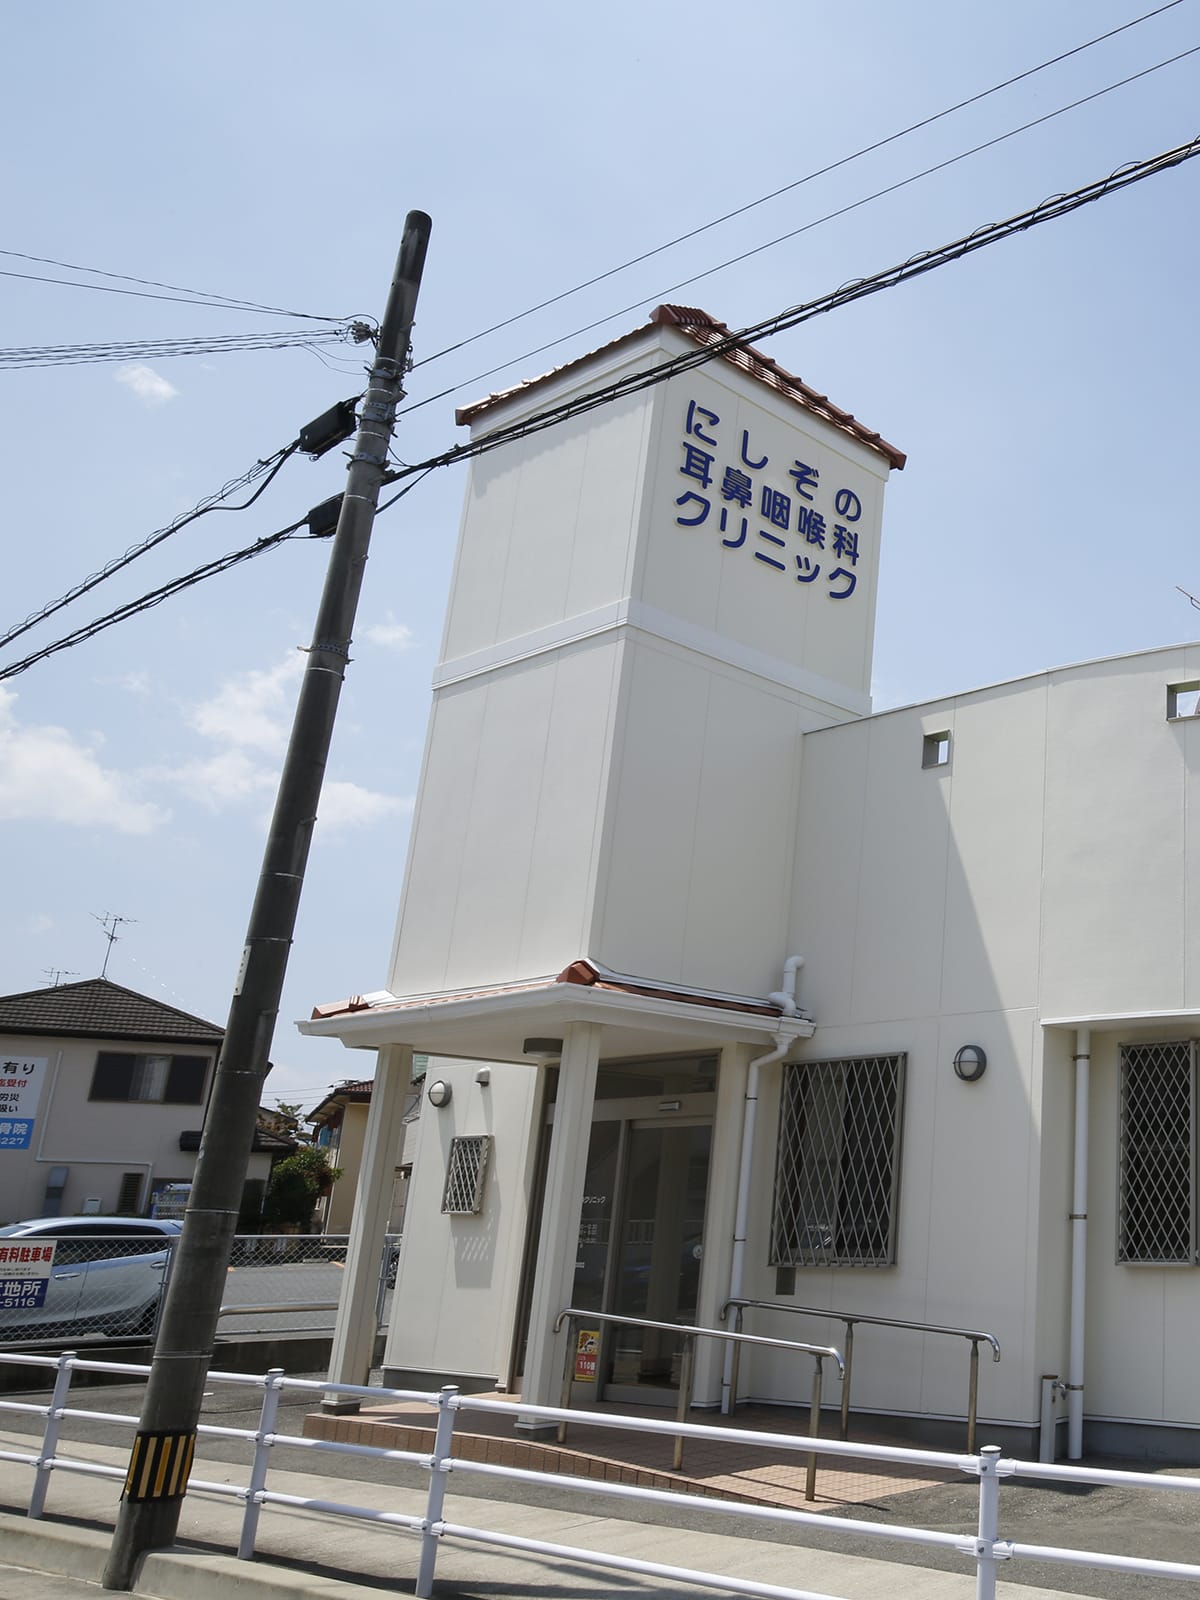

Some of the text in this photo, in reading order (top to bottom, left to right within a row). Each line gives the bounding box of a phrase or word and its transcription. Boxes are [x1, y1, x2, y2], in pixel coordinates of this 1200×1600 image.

[686, 400, 862, 522] にしぞの
[680, 441, 860, 566] 耳鼻咽喉科
[676, 491, 857, 599] クリニック
[3, 1061, 35, 1075] 有り
[0, 1247, 53, 1263] 有料駐車場
[0, 1281, 41, 1297] 地所
